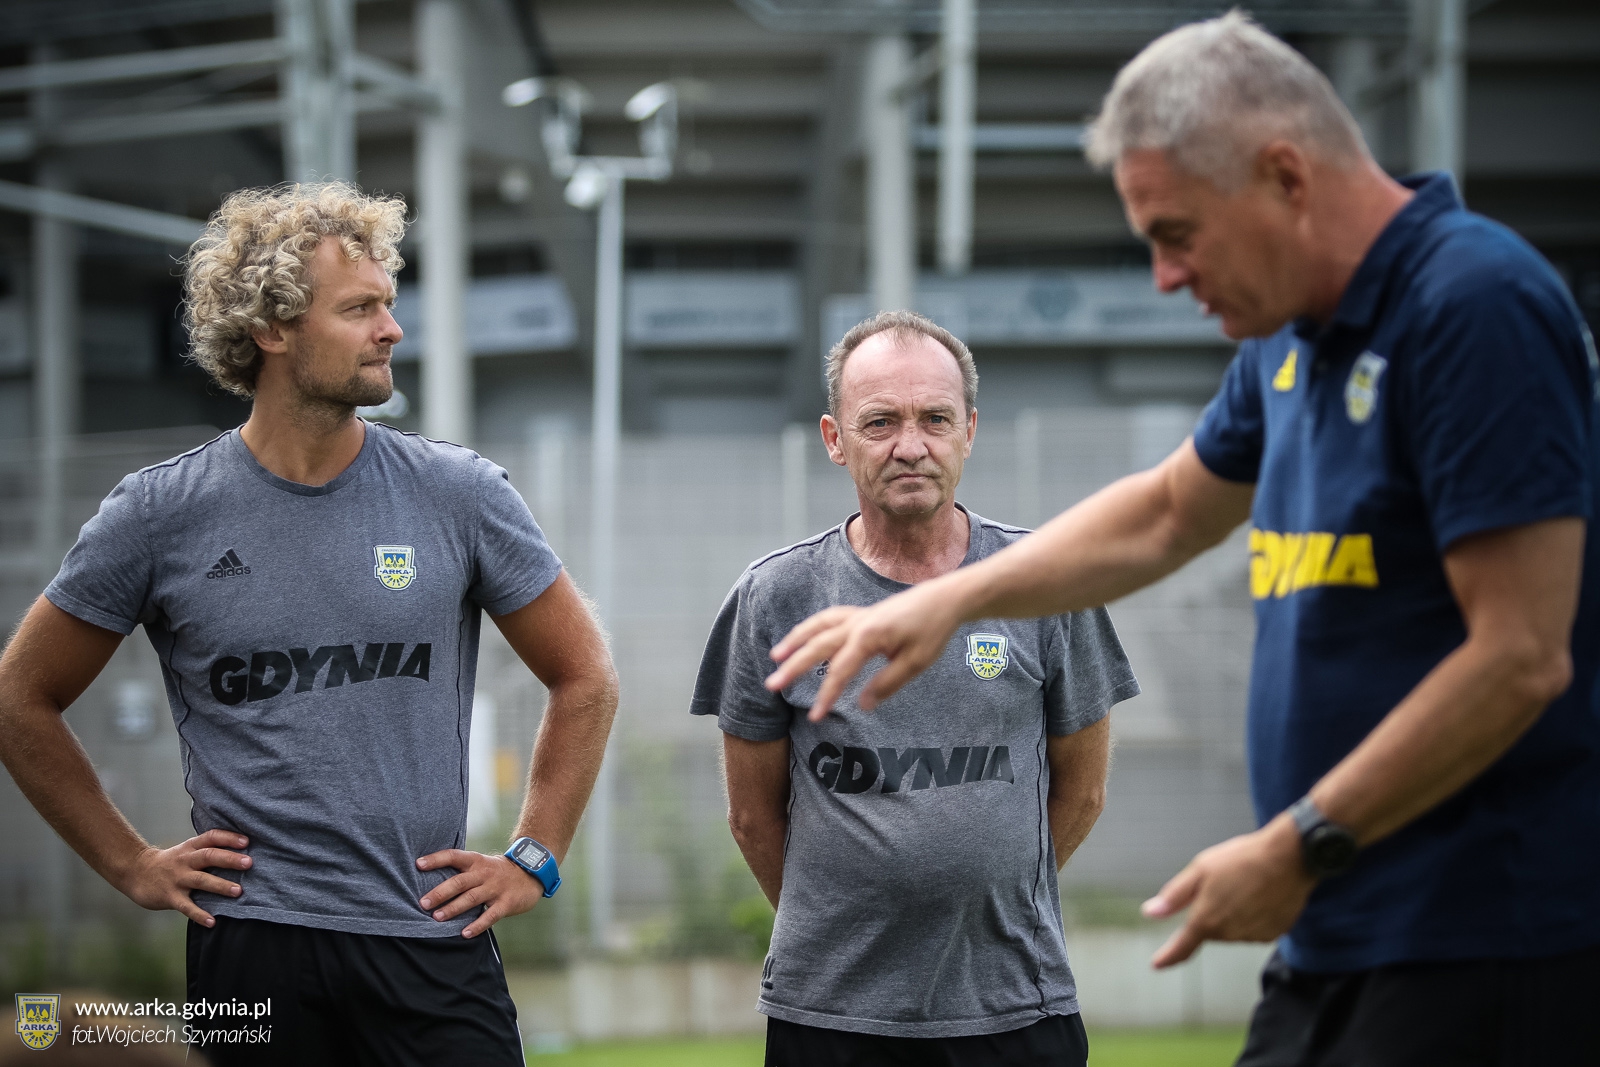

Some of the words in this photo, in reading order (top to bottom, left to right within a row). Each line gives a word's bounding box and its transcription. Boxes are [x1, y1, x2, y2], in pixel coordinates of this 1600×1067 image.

[206, 565, 251, 579] adidas
[209, 642, 432, 706] GDYNIA
[974, 657, 1001, 665] ARKA
[808, 741, 1015, 794] GDYNIA
